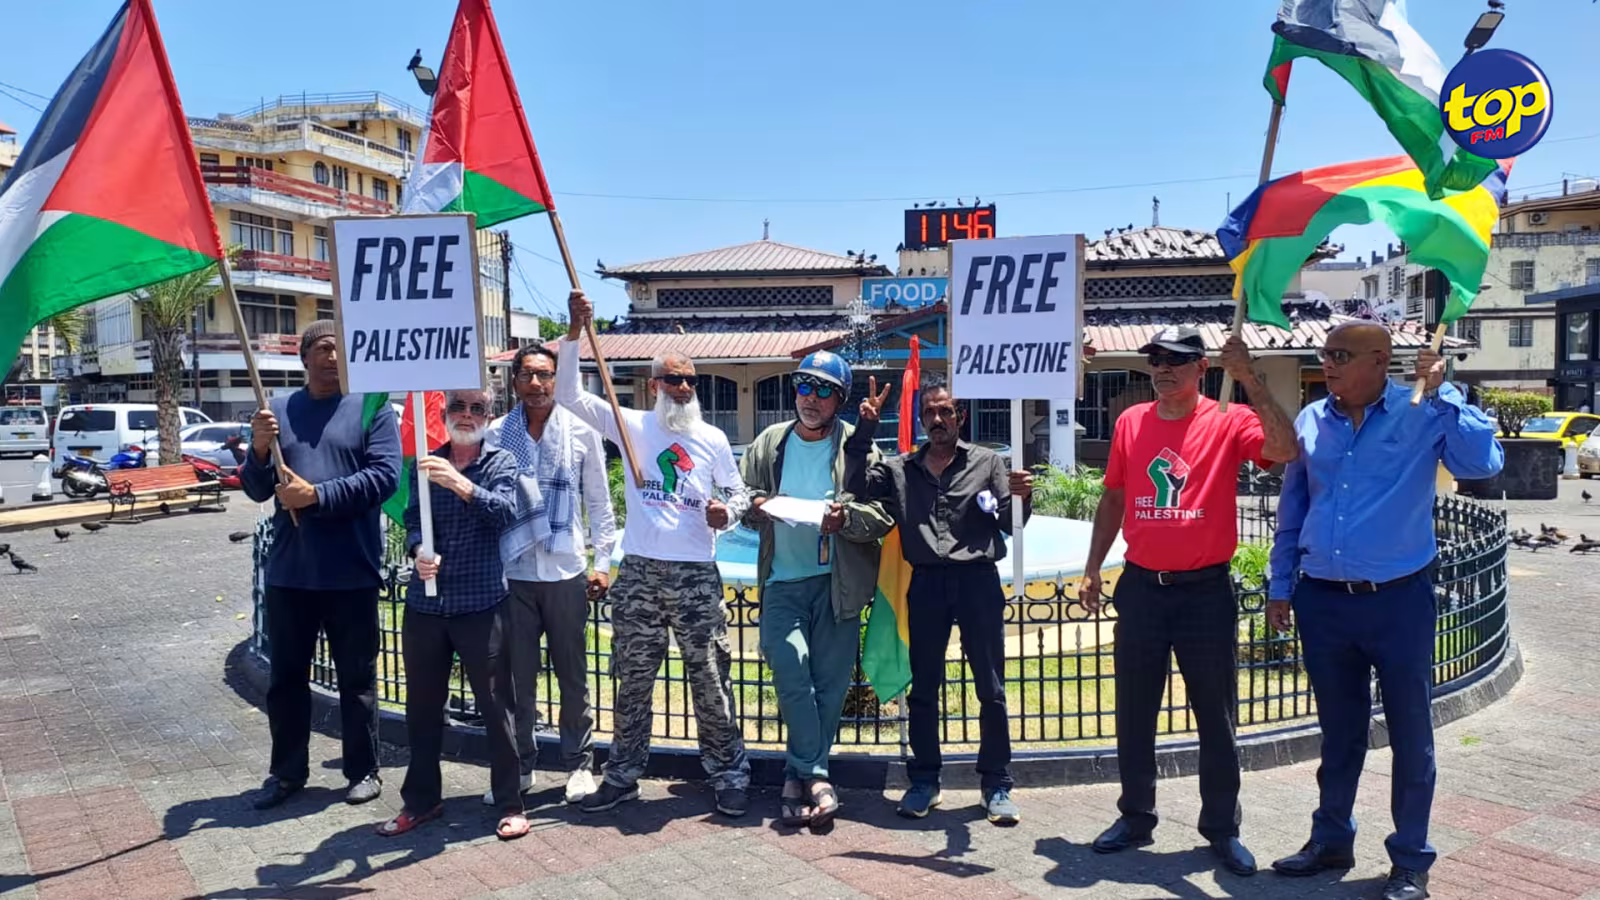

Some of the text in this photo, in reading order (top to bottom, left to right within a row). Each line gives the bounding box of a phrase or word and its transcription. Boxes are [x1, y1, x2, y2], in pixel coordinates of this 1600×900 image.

[350, 235, 459, 301] FREE
[871, 283, 937, 301] FOOD
[960, 252, 1066, 315] FREE
[350, 326, 473, 362] PALESTINE
[956, 342, 1071, 374] PALESTINE
[643, 480, 661, 490] FREE
[642, 491, 702, 508] PALESINE
[1135, 496, 1153, 508] FREE
[1135, 509, 1204, 519] PALESTINE
